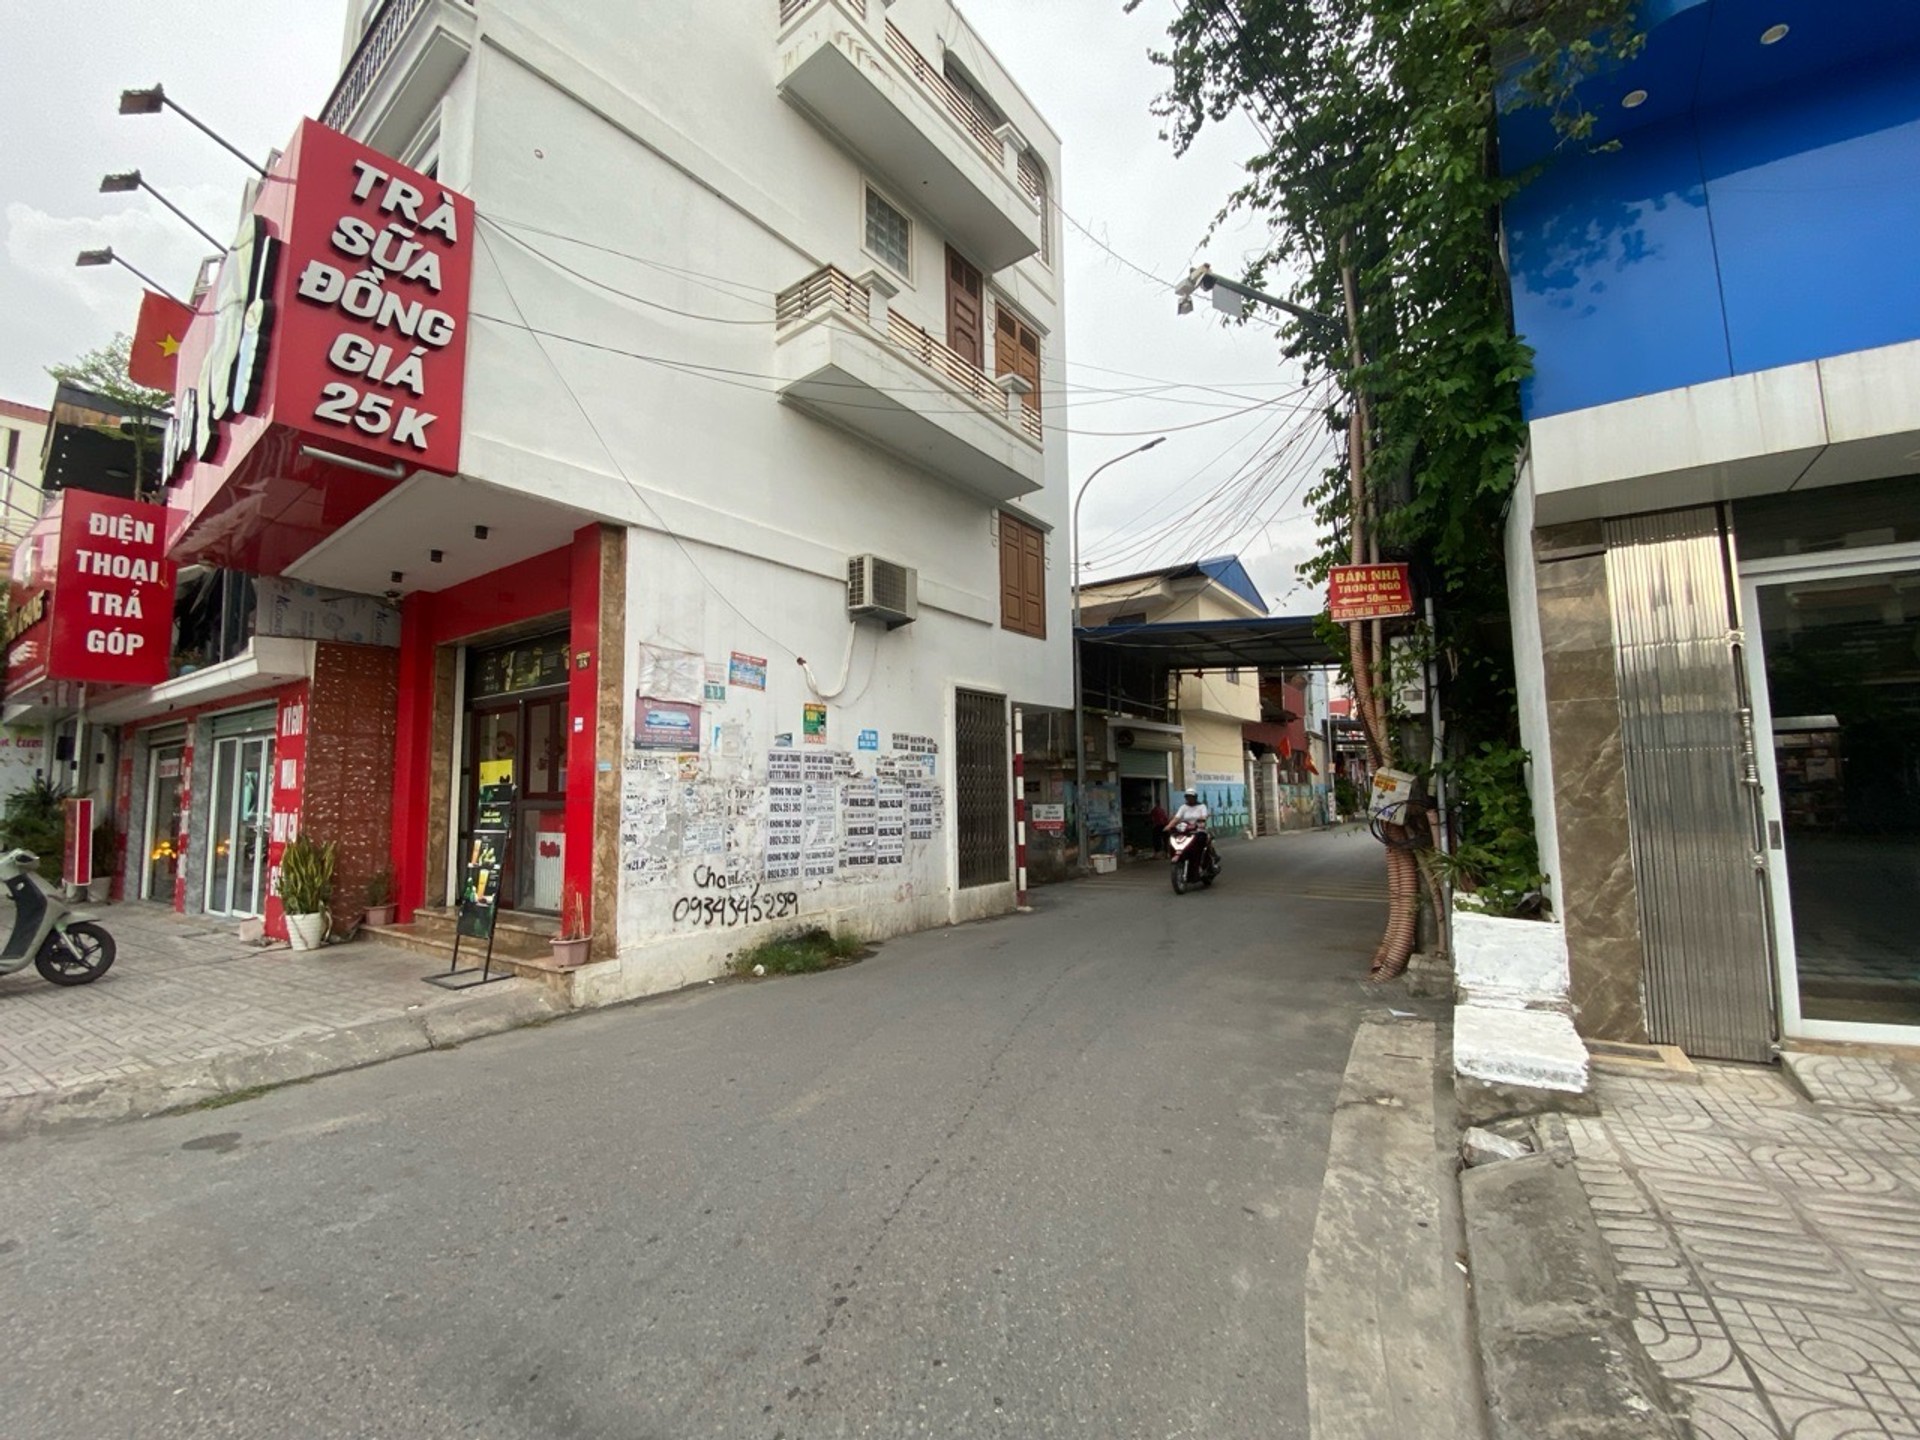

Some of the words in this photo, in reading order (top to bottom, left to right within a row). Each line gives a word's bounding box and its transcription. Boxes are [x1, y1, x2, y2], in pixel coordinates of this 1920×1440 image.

[353, 159, 458, 242] TRÀ
[331, 216, 443, 291] SỮA
[297, 260, 457, 347] ĐỒNG
[329, 332, 425, 395] GIÁ
[315, 382, 438, 449] 25K
[89, 512, 156, 546] ĐIỆN
[76, 549, 160, 585] THOẠI
[88, 588, 144, 620] TRẢ
[1338, 583, 1376, 594] TRONG
[86, 627, 145, 656] GÓP
[672, 891, 799, 926] 0934345229
